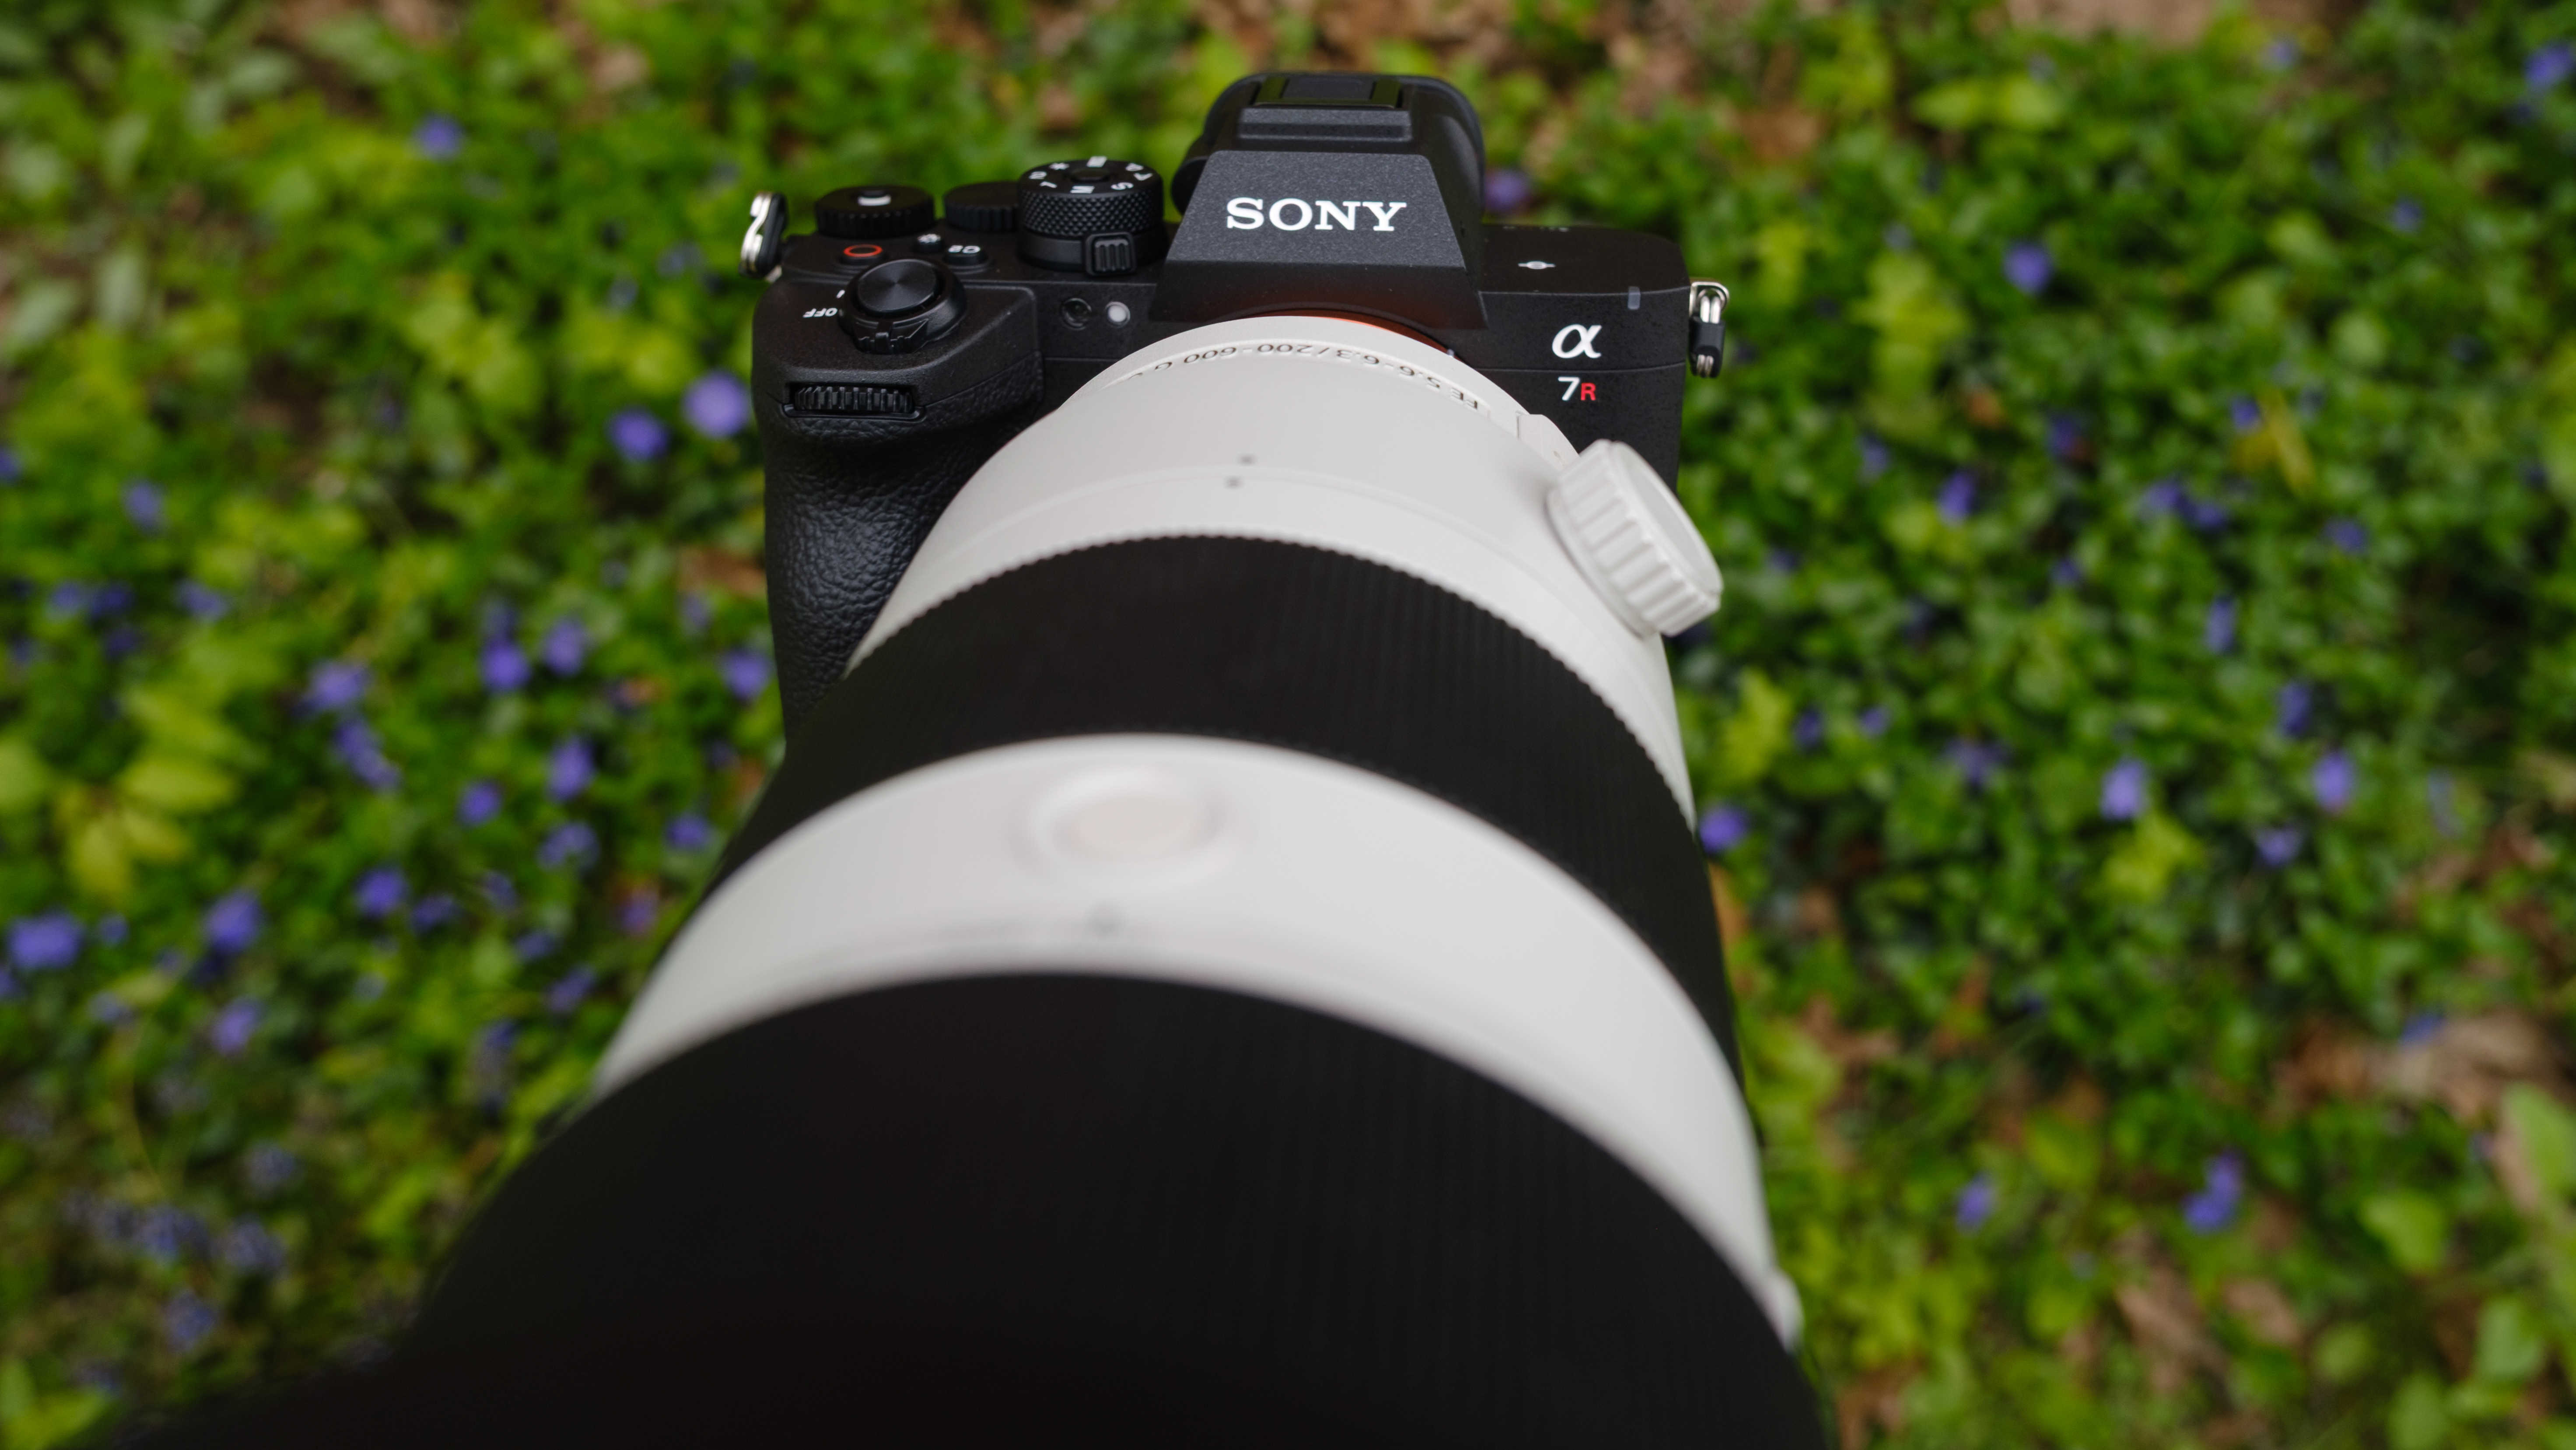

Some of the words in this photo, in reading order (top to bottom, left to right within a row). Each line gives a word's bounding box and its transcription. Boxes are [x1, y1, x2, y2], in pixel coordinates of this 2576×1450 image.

[1227, 197, 1407, 231] SONY
[803, 308, 838, 318] OFF
[1155, 362, 1173, 372] G
[1450, 386, 1478, 411] FE
[1558, 376, 1596, 401] 7R
